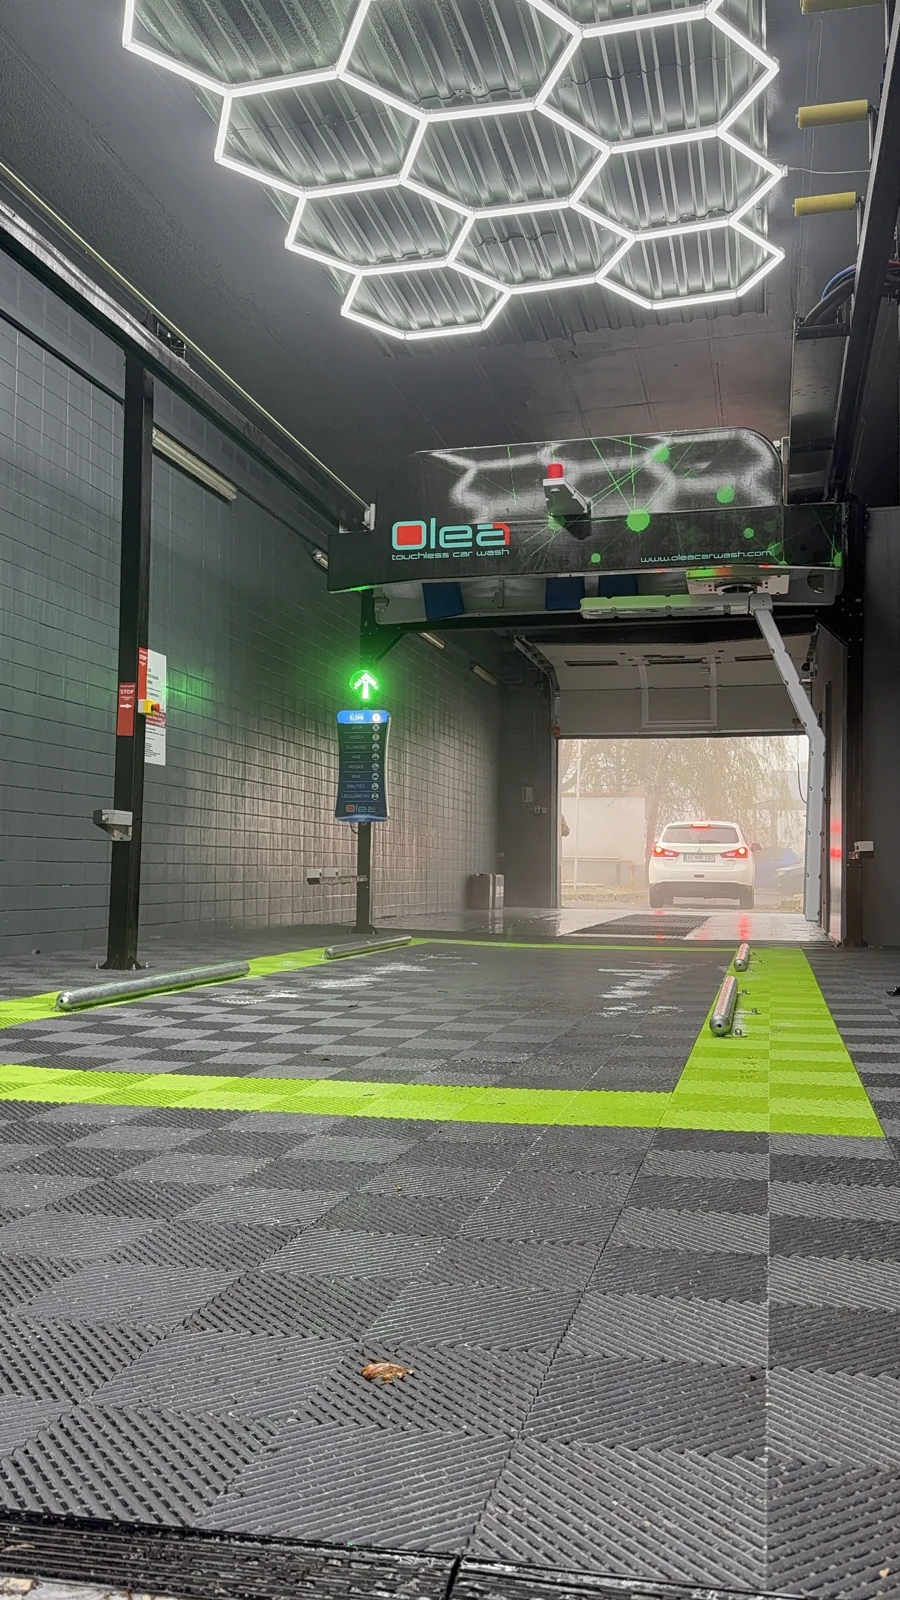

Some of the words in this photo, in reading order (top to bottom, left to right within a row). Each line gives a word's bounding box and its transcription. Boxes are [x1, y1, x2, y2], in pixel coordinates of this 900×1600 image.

[392, 552, 450, 561] touchless
[452, 550, 474, 558] car
[476, 548, 510, 557] wash
[640, 549, 774, 563] www.oleacarwash.com
